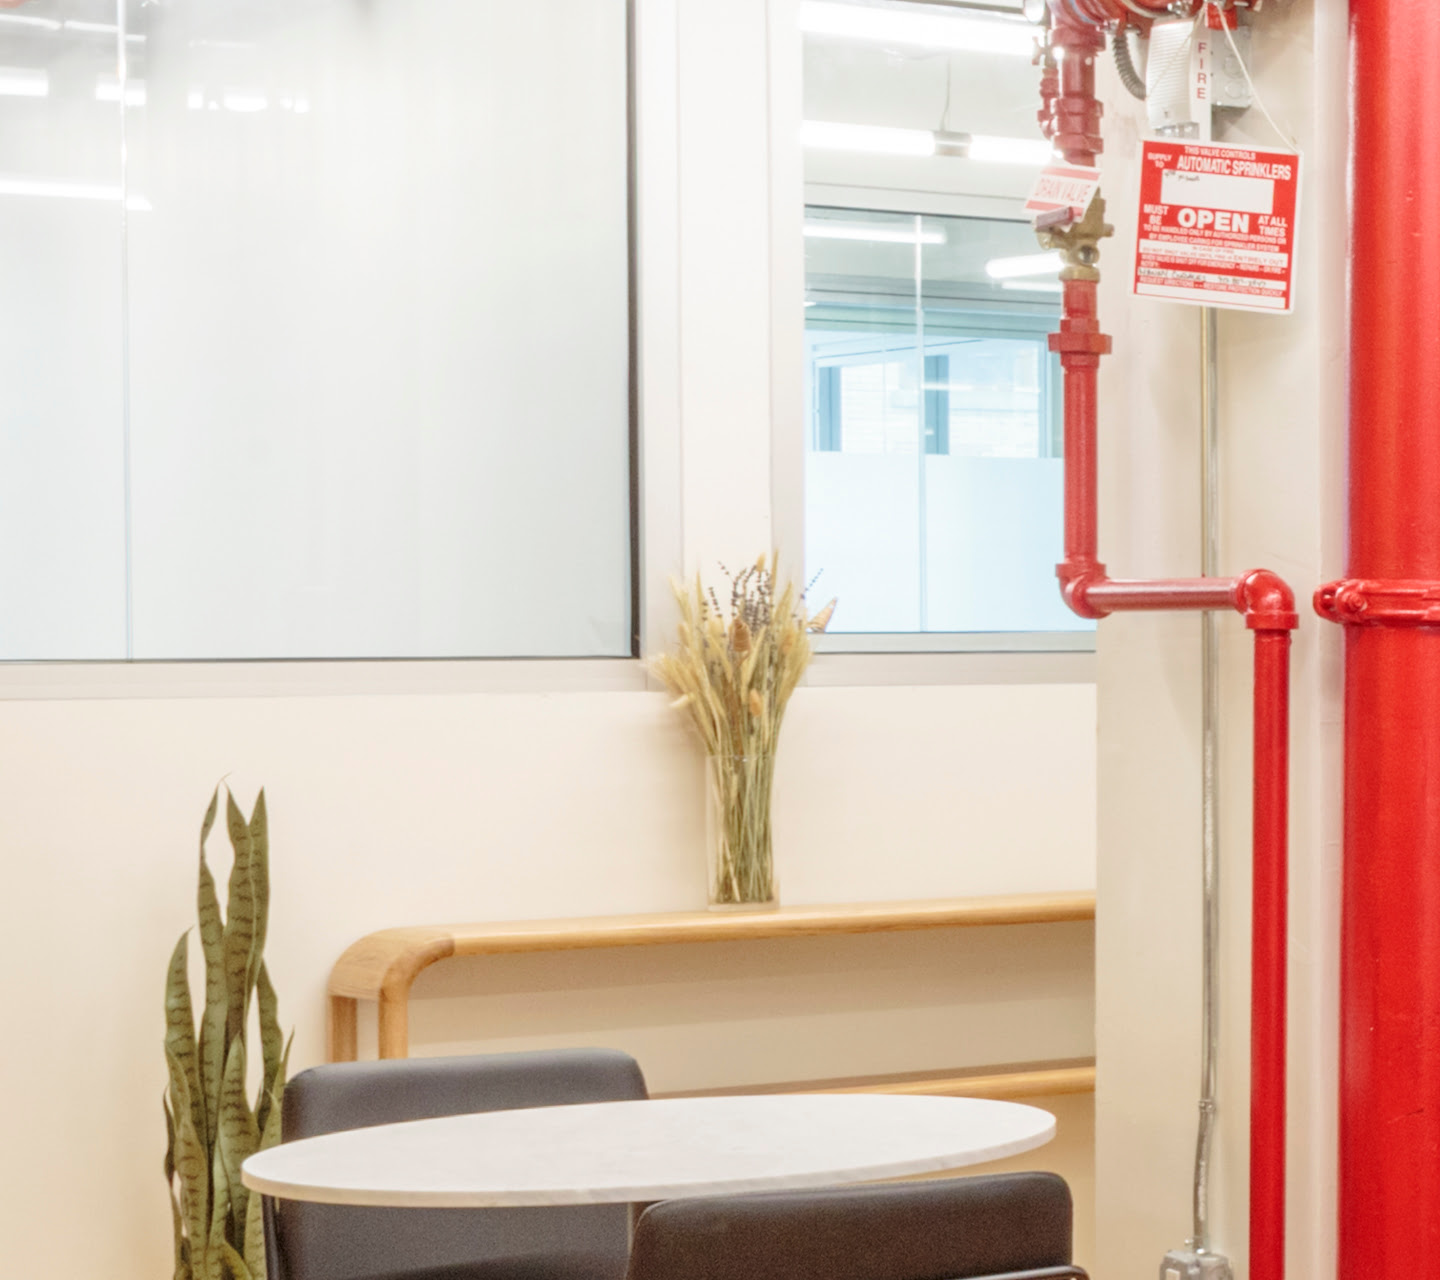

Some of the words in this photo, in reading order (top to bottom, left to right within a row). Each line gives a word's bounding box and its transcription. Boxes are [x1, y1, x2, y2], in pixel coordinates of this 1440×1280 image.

[1196, 41, 1208, 100] FIRE
[1147, 152, 1172, 161] SUPPLY
[1184, 146, 1199, 155] THIS
[1200, 148, 1220, 156] VALVE
[1220, 150, 1255, 160] CONTROLS
[1154, 160, 1164, 168] TO
[1176, 154, 1232, 174] AUTOMATIC
[1231, 159, 1291, 180] SPRINKLERS
[1143, 203, 1169, 215] MUST
[1148, 214, 1161, 225] BE
[1177, 207, 1249, 233] OPEN
[1257, 214, 1269, 225] AT
[1269, 216, 1288, 226] ALL
[1258, 225, 1286, 237] TIMES
